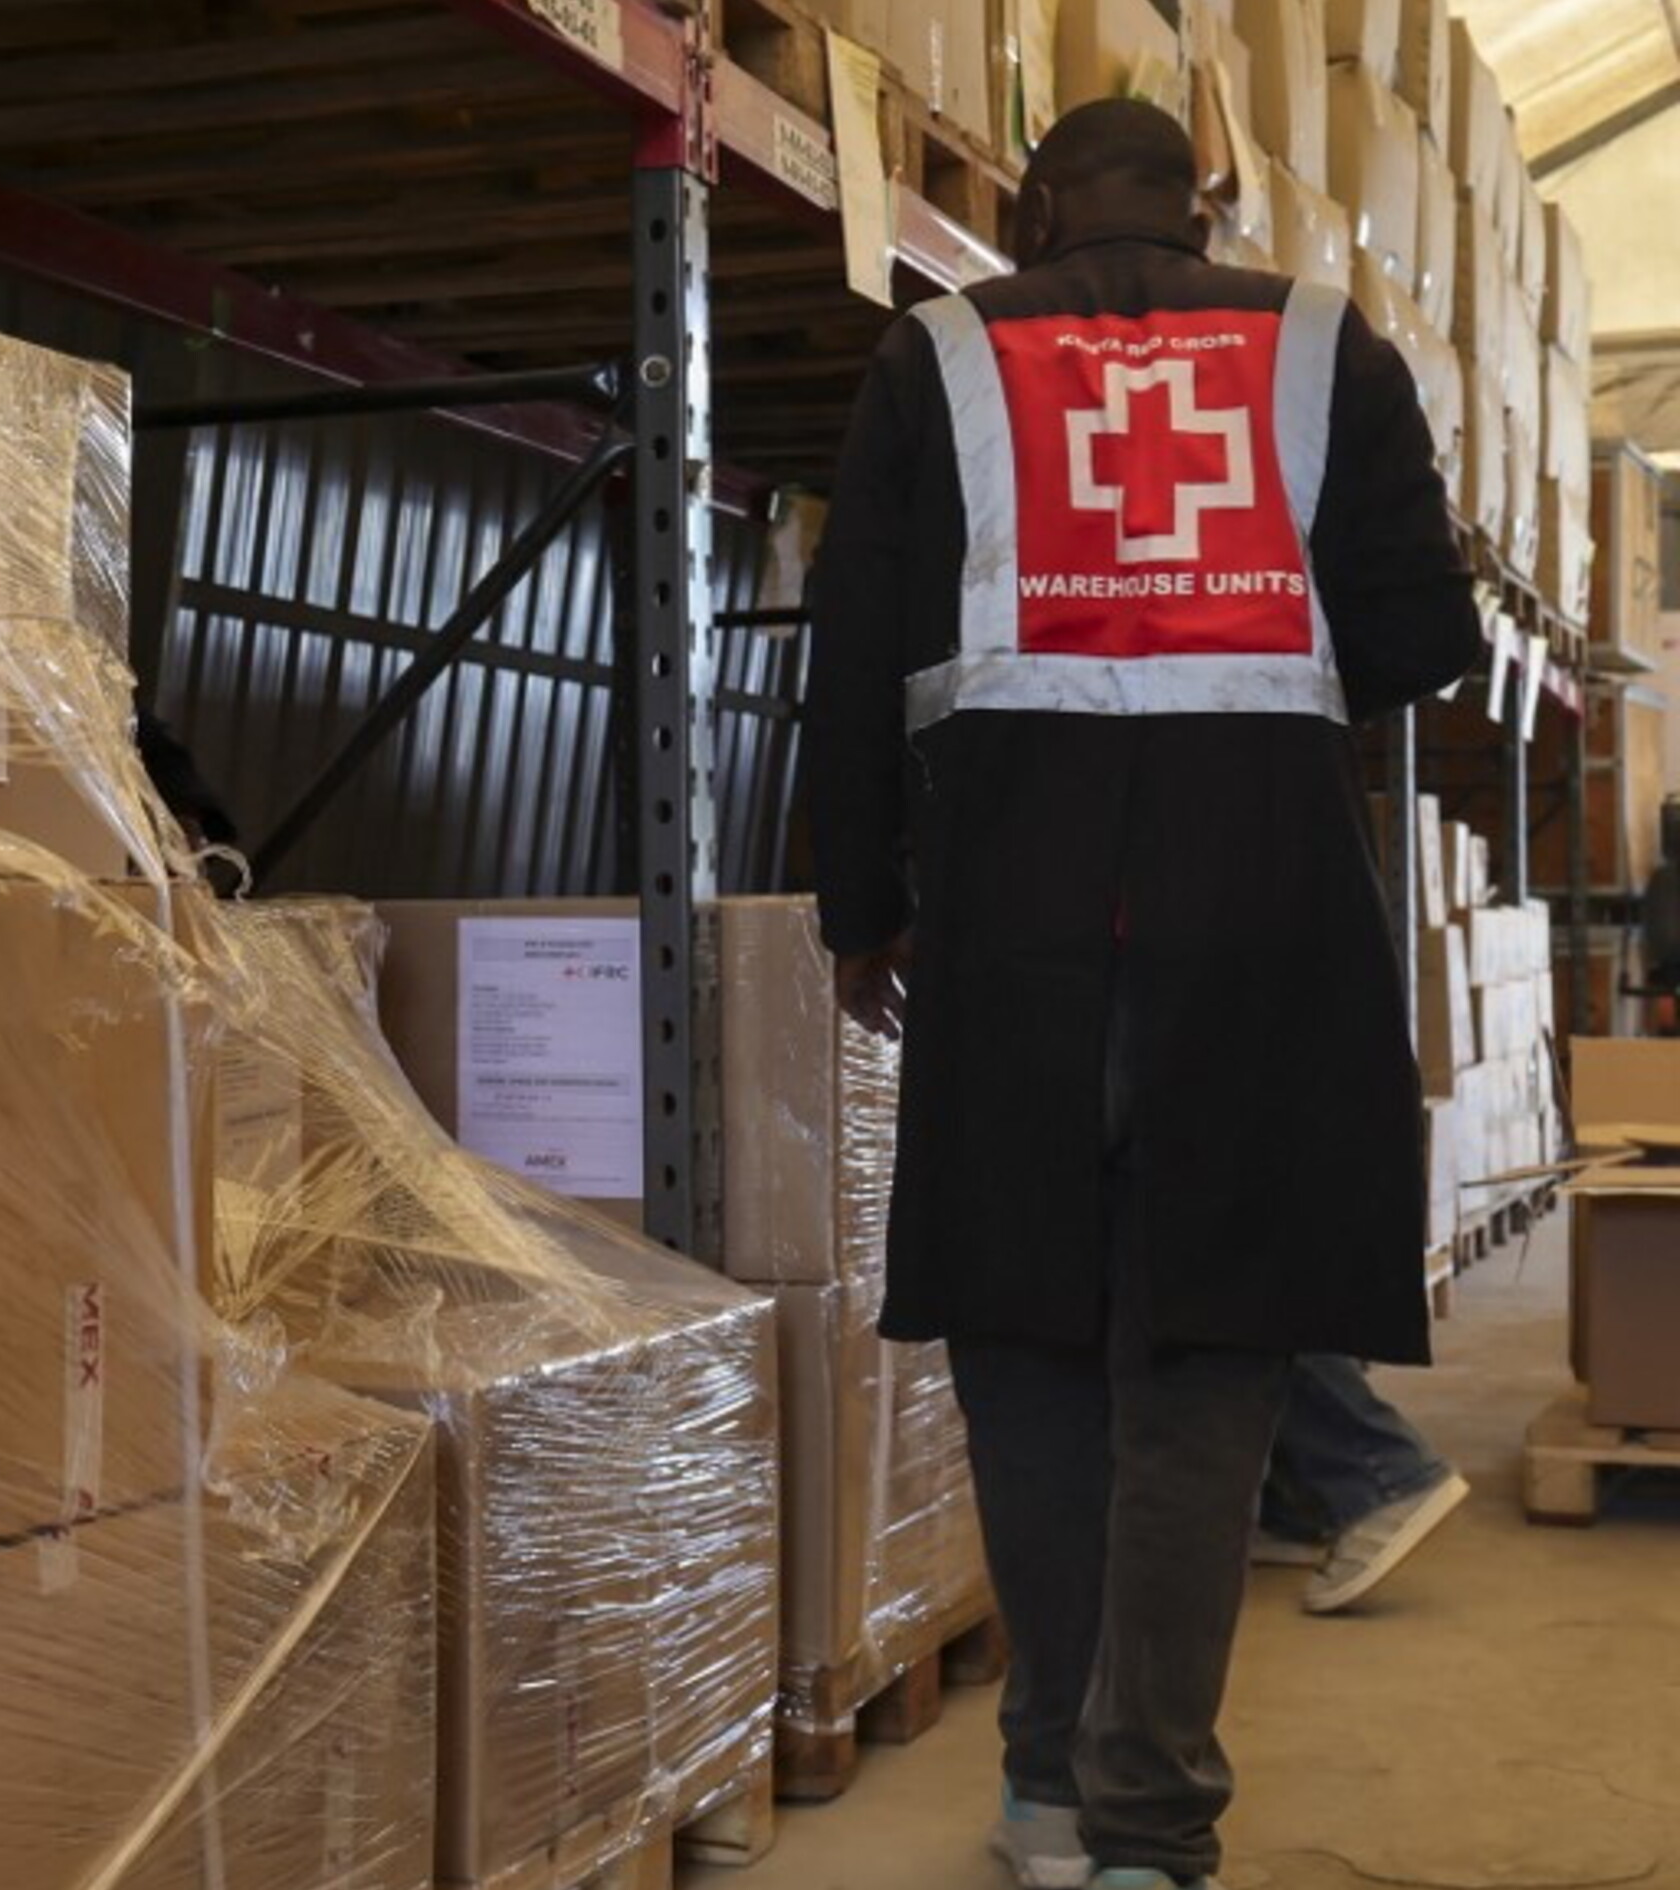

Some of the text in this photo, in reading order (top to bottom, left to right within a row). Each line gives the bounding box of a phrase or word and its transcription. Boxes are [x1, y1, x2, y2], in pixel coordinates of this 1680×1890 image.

[1170, 333, 1247, 350] CROSS
[1019, 570, 1307, 599] WAREHOUSE UNITS
